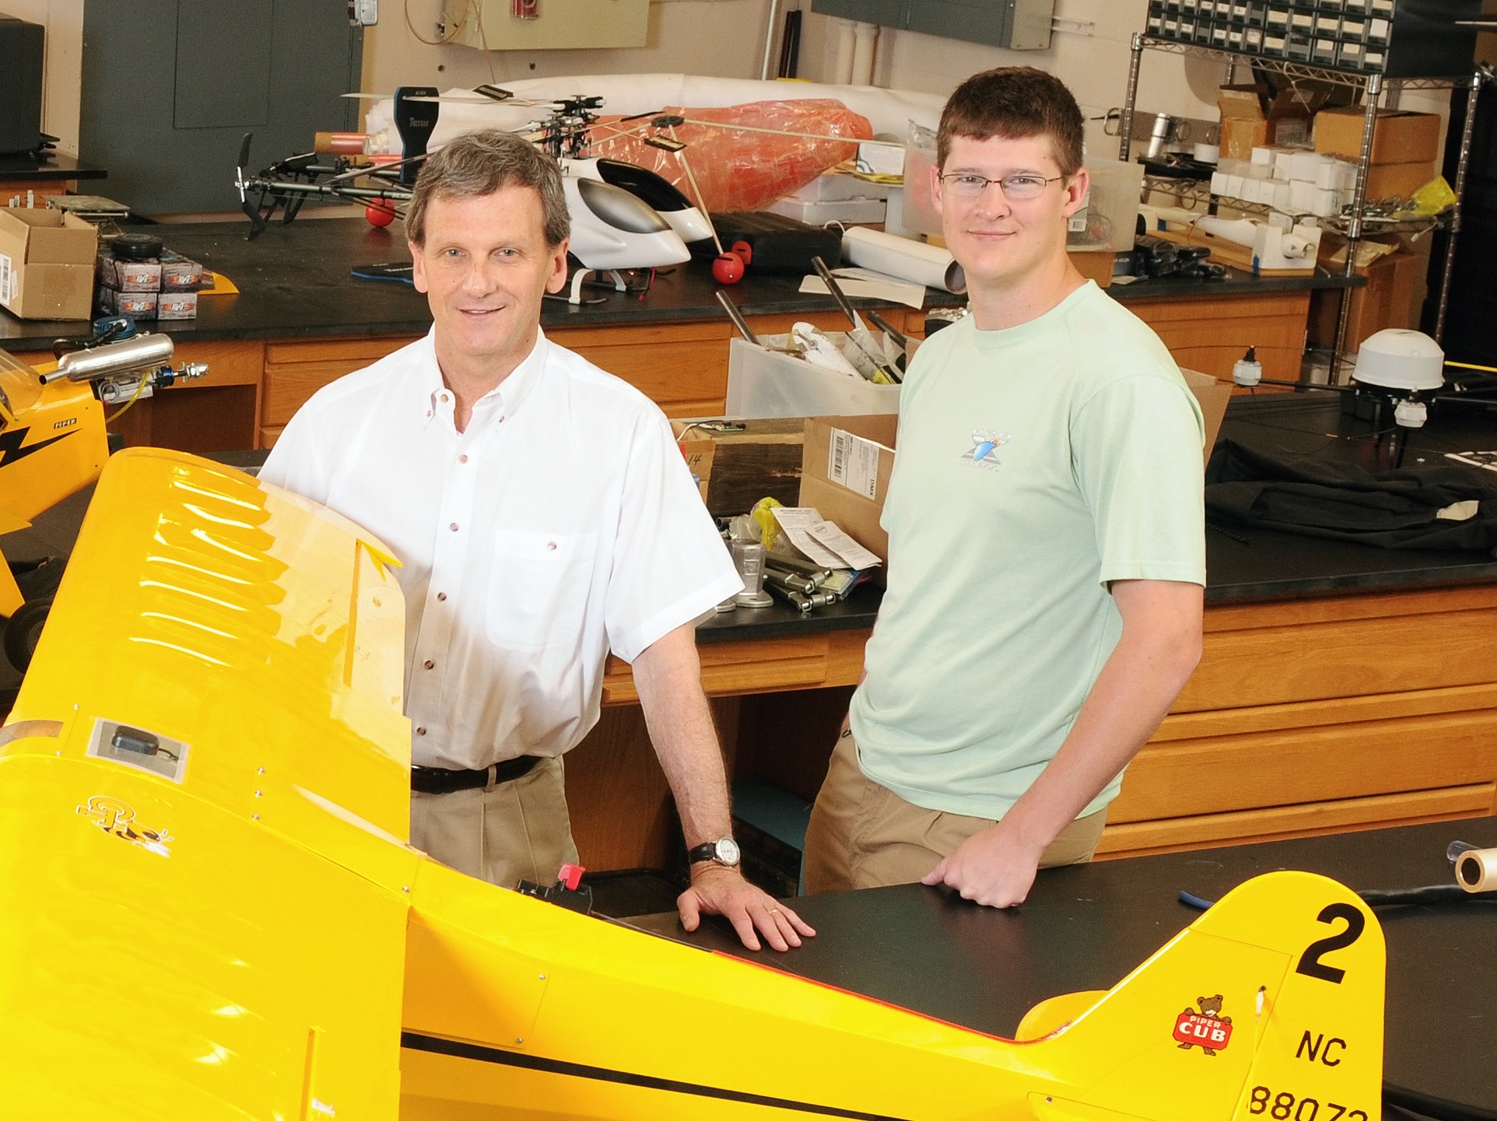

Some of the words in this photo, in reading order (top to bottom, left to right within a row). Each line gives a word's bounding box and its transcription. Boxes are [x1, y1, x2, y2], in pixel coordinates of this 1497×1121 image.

[1295, 902, 1366, 985] 2
[1178, 1021, 1227, 1043] CUB
[1189, 1015, 1221, 1029] PIPER
[1295, 1030, 1347, 1067] NC
